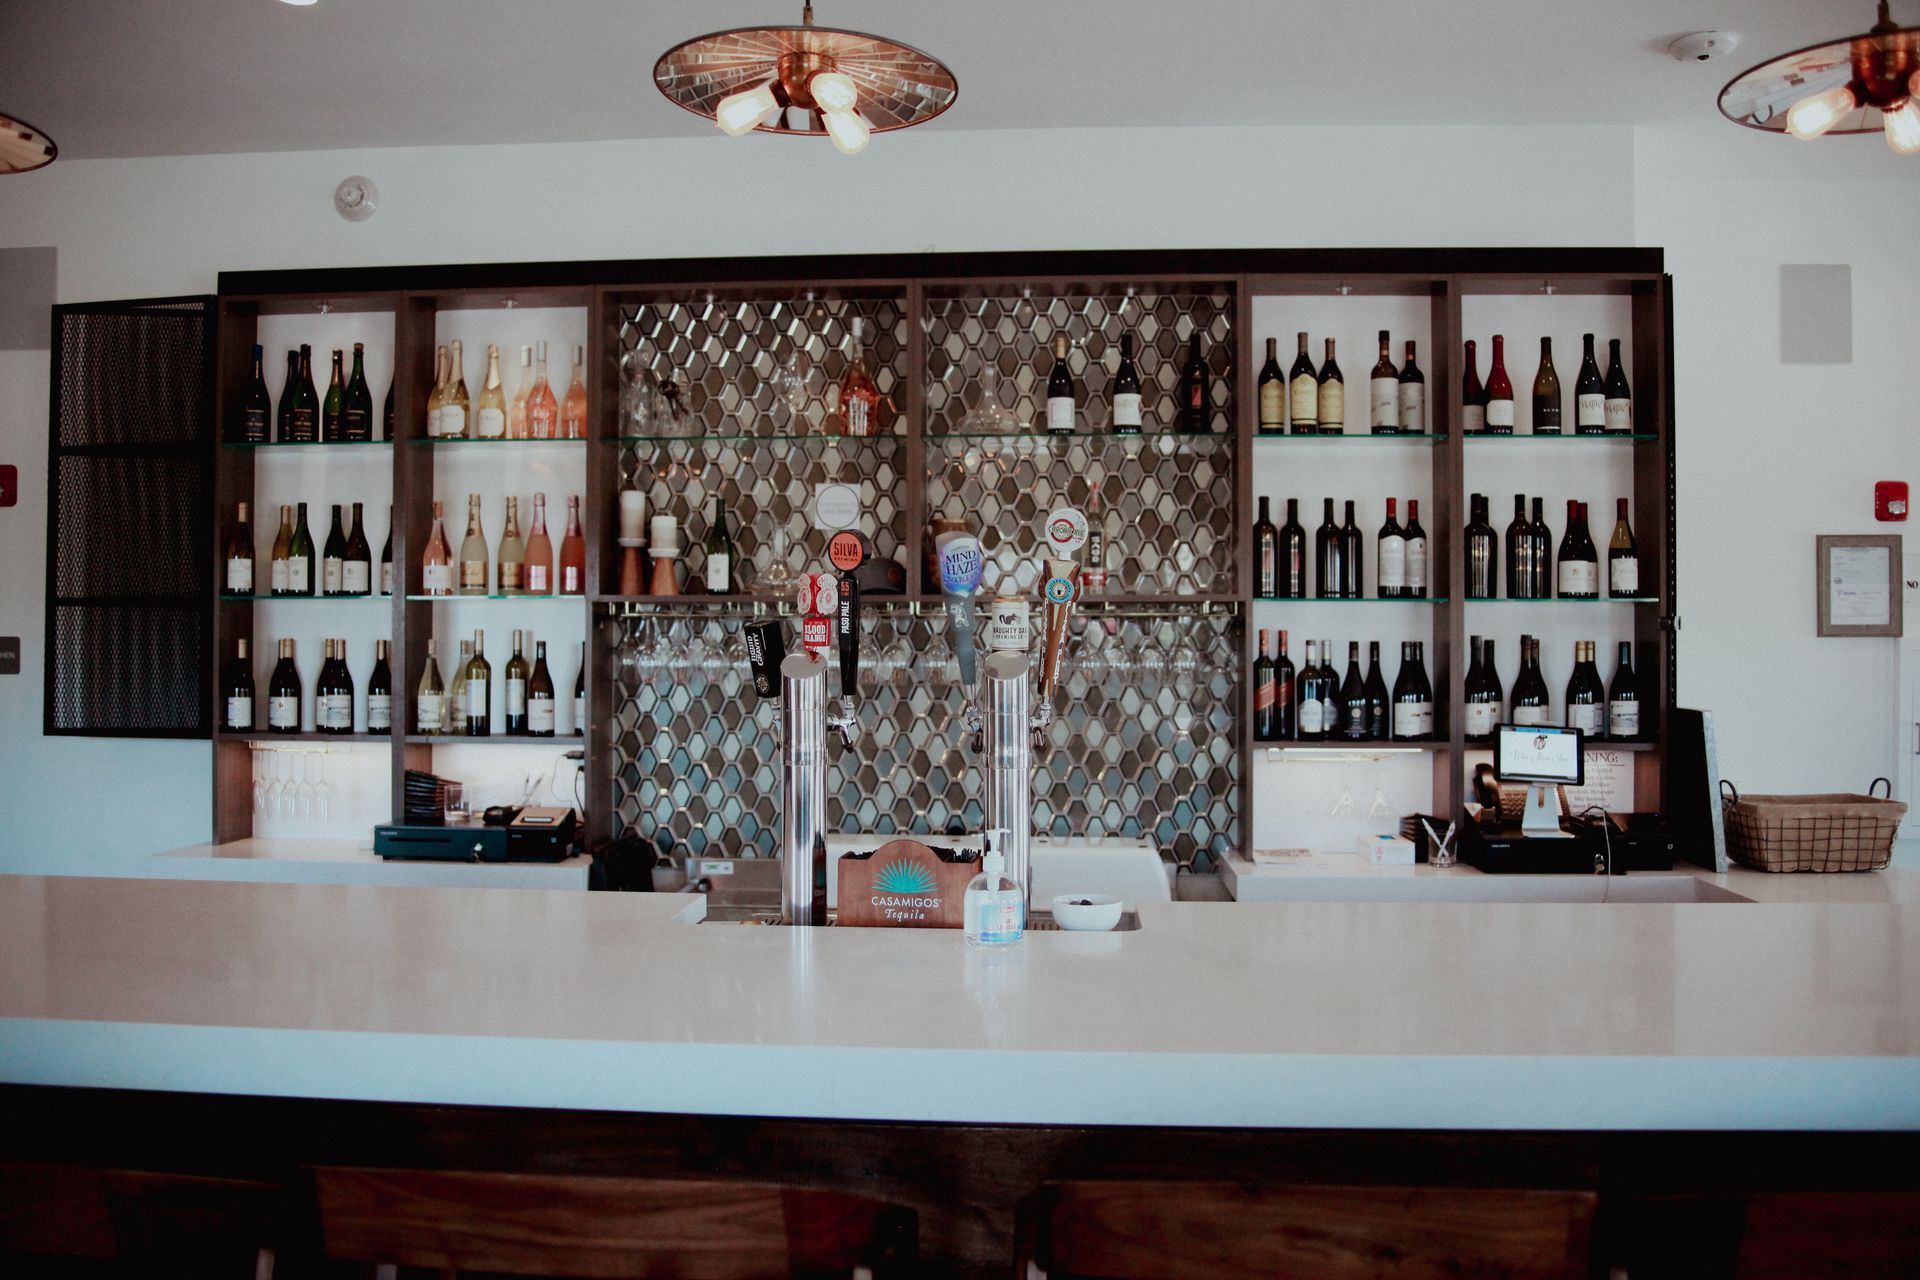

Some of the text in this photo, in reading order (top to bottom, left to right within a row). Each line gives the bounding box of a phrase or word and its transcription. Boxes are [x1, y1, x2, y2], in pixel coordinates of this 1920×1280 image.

[834, 541, 858, 556] SILVA
[945, 550, 976, 564] MIND
[947, 560, 978, 576] HAZE
[841, 601, 850, 616] PALE
[804, 624, 826, 634] BLOOD
[841, 618, 850, 634] PASO
[748, 636, 757, 662] LIQUID
[752, 633, 764, 666] GRAVITY
[1585, 752, 1618, 762] NING:
[872, 896, 939, 907] CASAMIGOS
[884, 908, 924, 922] Tequila
